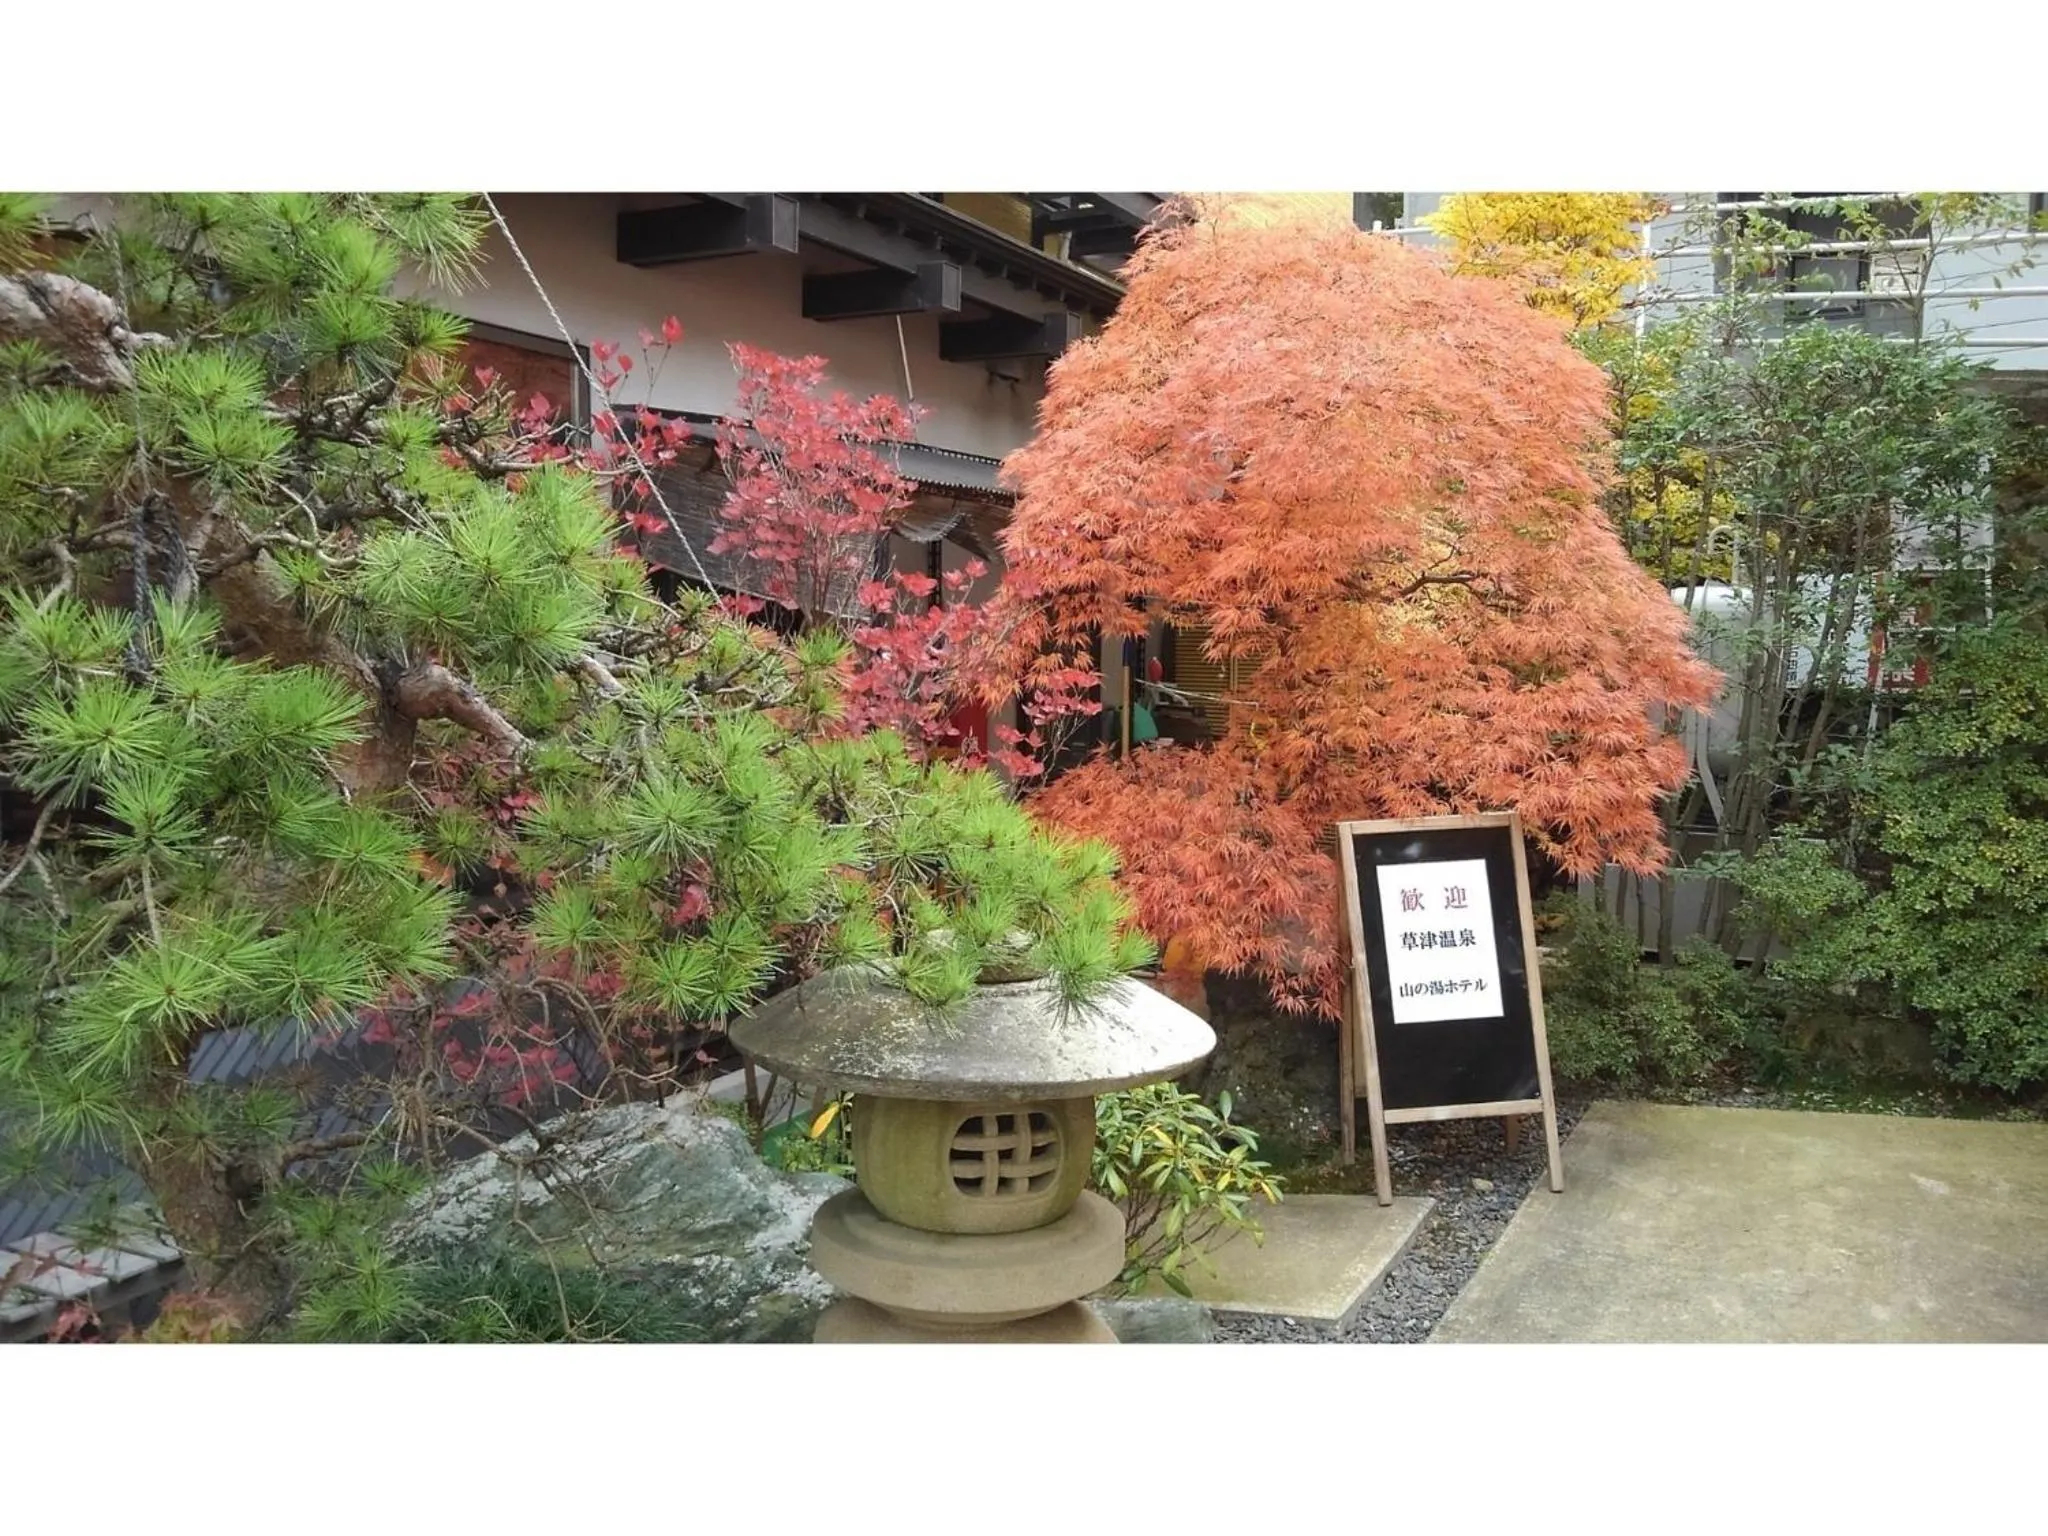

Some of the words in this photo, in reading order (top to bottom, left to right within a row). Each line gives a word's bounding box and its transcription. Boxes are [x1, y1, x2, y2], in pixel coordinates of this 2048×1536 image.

[1400, 928, 1476, 951] 草津温泉
[1399, 977, 1488, 998] 山の湯ホテル
